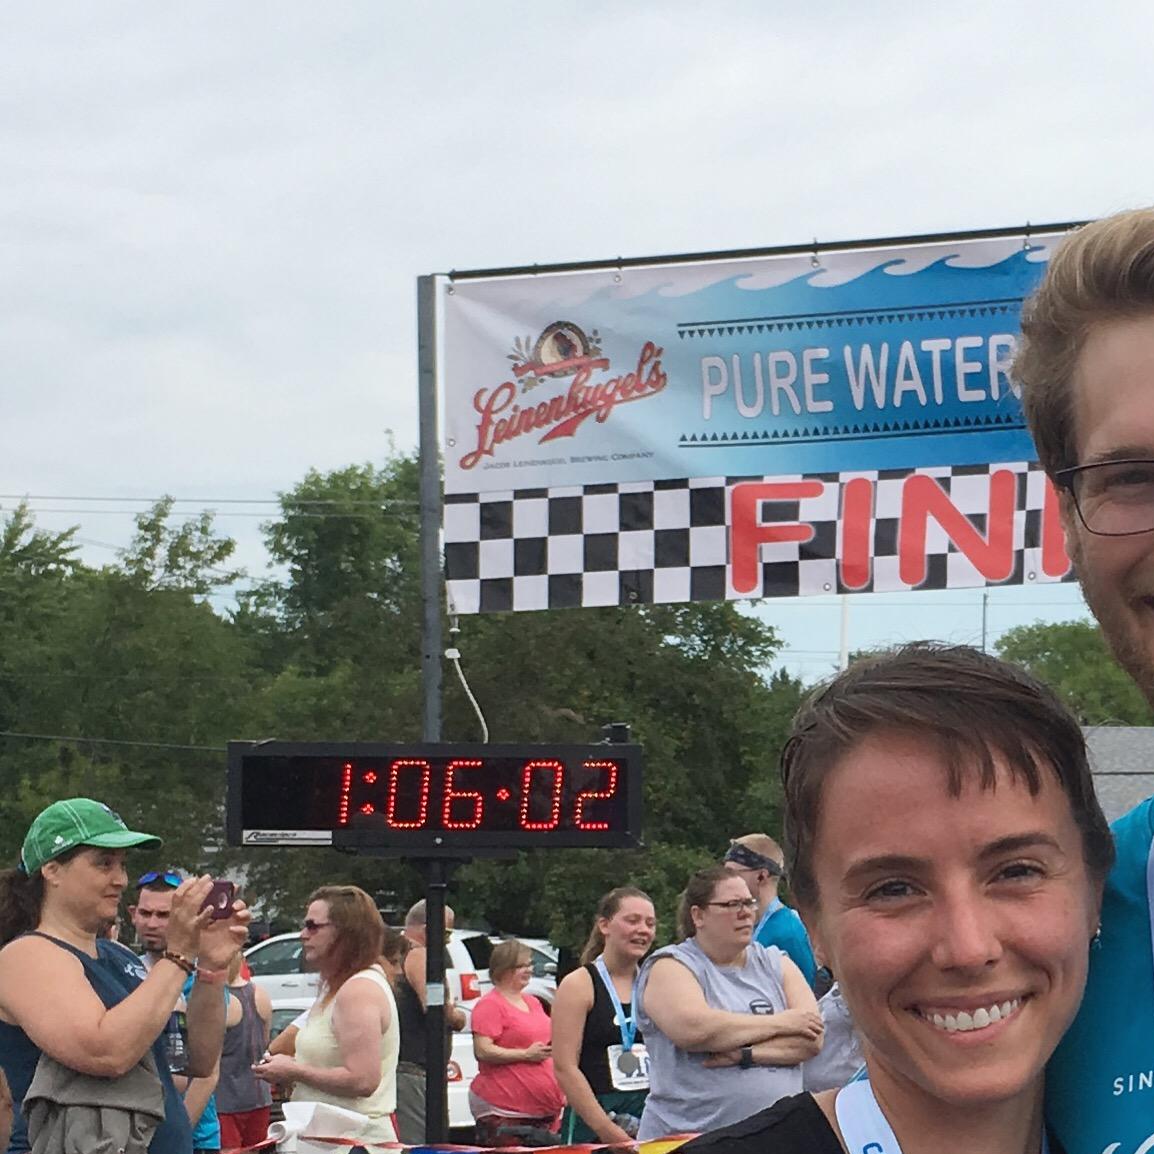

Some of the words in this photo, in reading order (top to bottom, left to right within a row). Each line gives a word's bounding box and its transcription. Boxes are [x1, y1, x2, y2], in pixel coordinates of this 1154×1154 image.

[459, 340, 668, 470] Leinenkugel's
[701, 347, 834, 421] PURE
[843, 333, 1023, 411] WATER
